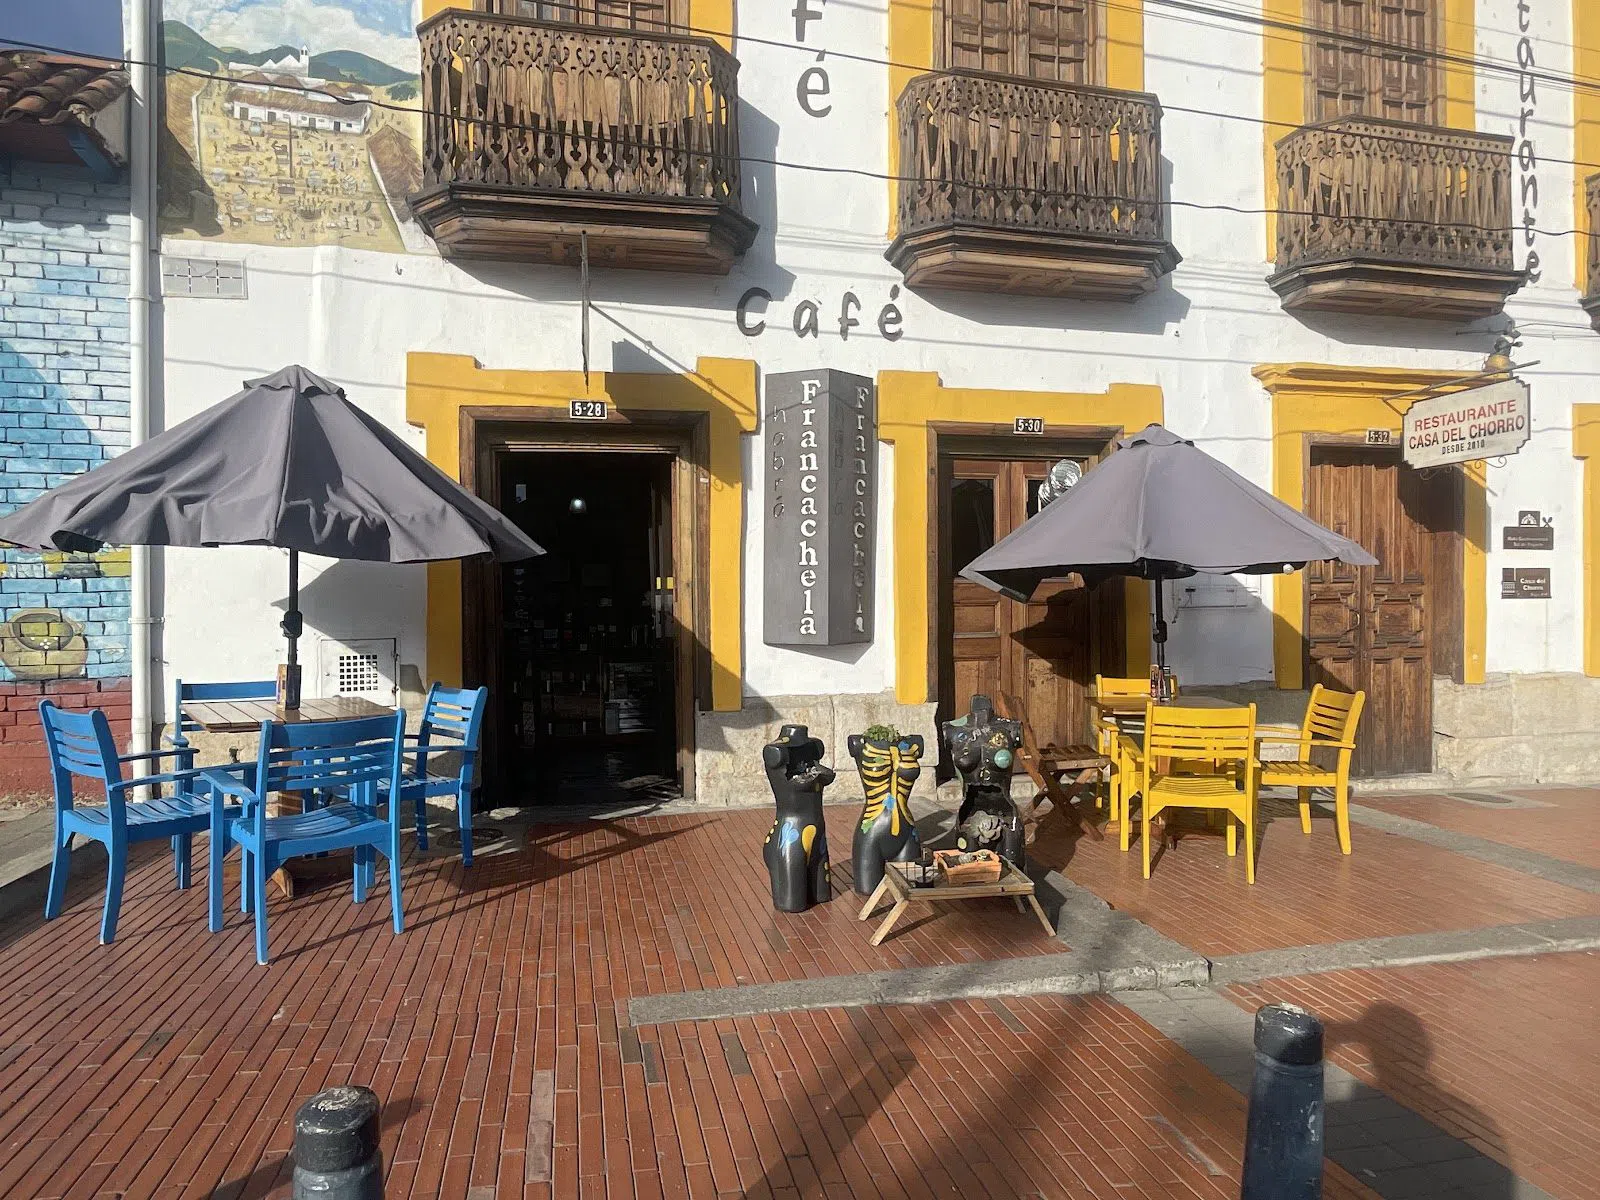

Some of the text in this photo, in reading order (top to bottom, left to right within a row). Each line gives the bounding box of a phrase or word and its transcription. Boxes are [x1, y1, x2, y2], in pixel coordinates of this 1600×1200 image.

[736, 284, 904, 342] Café
[574, 402, 602, 416] 5-28
[1017, 419, 1040, 432] 5-30
[1414, 399, 1517, 432] RESTAURANTE
[1408, 415, 1525, 449] CASA DEL CHORRO
[1441, 439, 1486, 455] DESDE 2010
[799, 380, 821, 635] Francachela
[853, 385, 869, 633] Francachela
